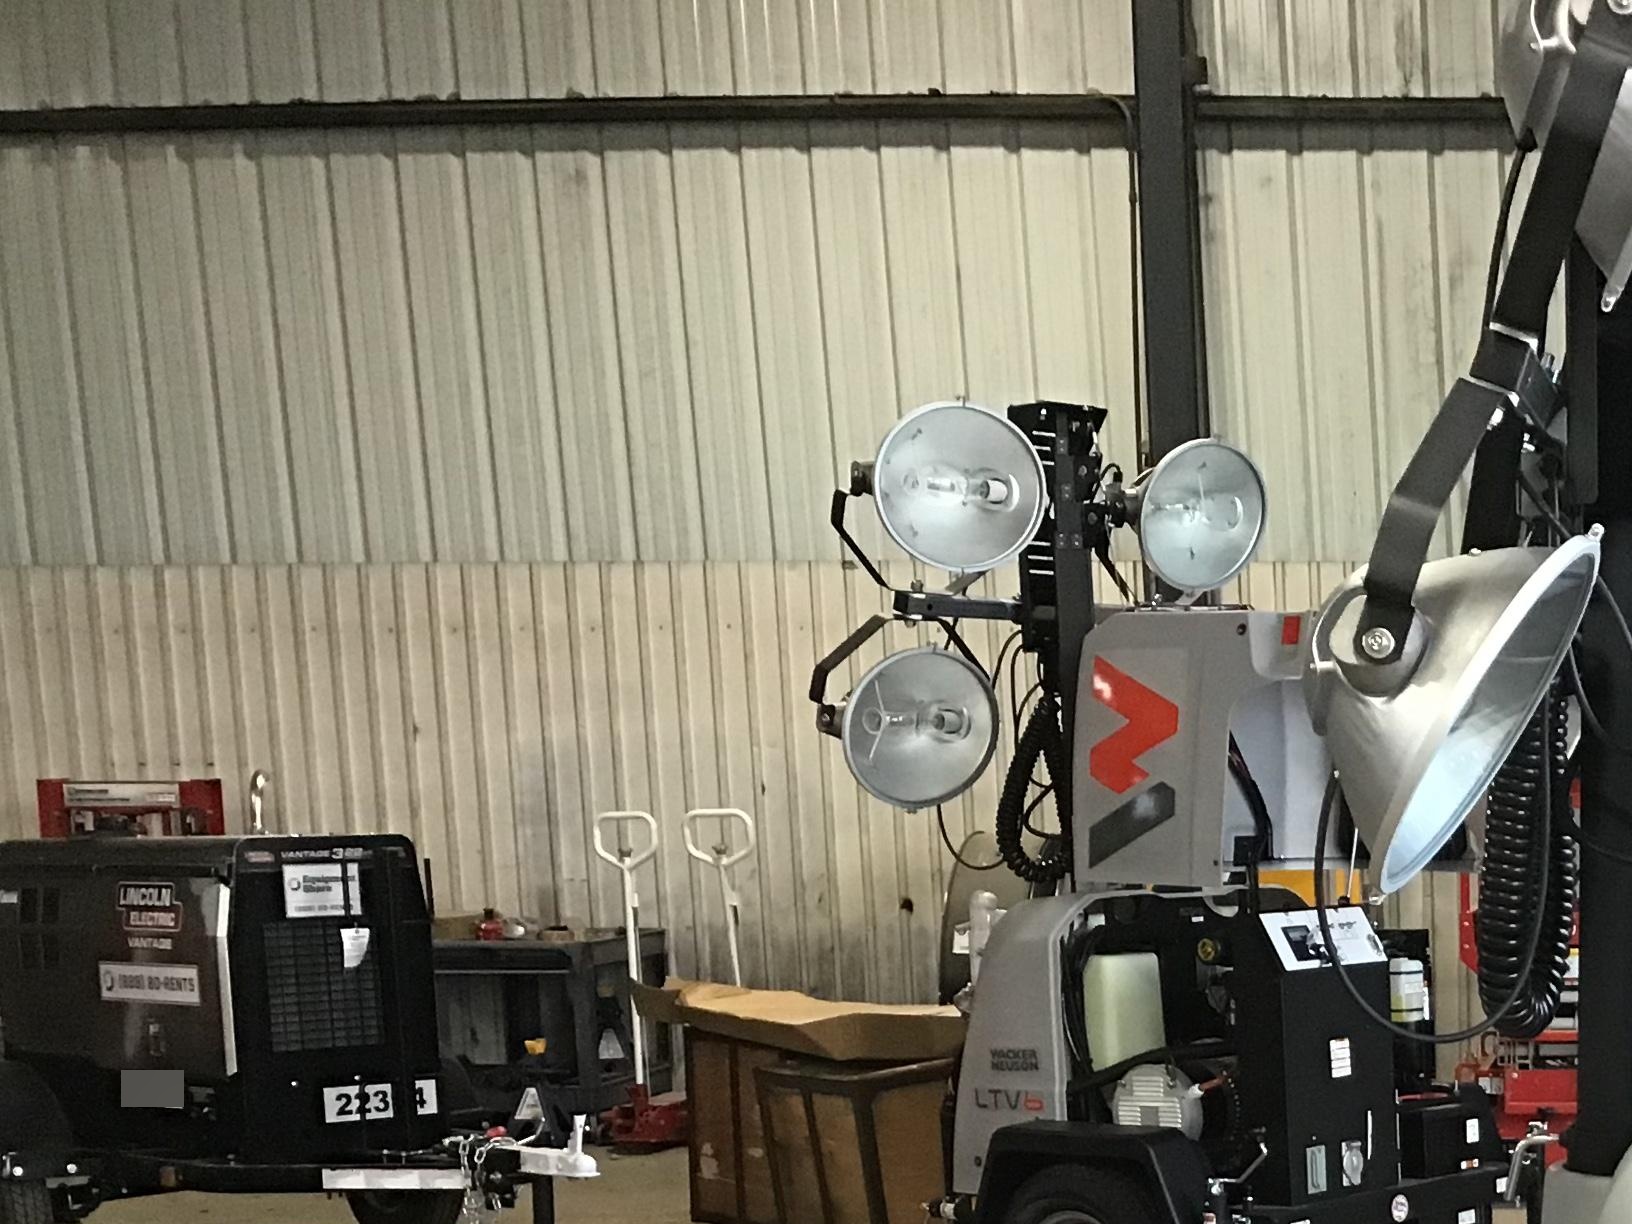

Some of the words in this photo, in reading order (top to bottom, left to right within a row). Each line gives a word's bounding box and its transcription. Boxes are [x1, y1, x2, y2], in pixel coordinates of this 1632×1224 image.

[281, 850, 330, 858] VANTAGE
[119, 887, 171, 907] LINCOLN
[129, 911, 175, 926] ELECTRIC
[127, 937, 172, 949] VANTAGE
[990, 1048, 1037, 1060] WACKER
[991, 1060, 1039, 1072] NEUSON
[974, 1088, 1045, 1111] LTV6
